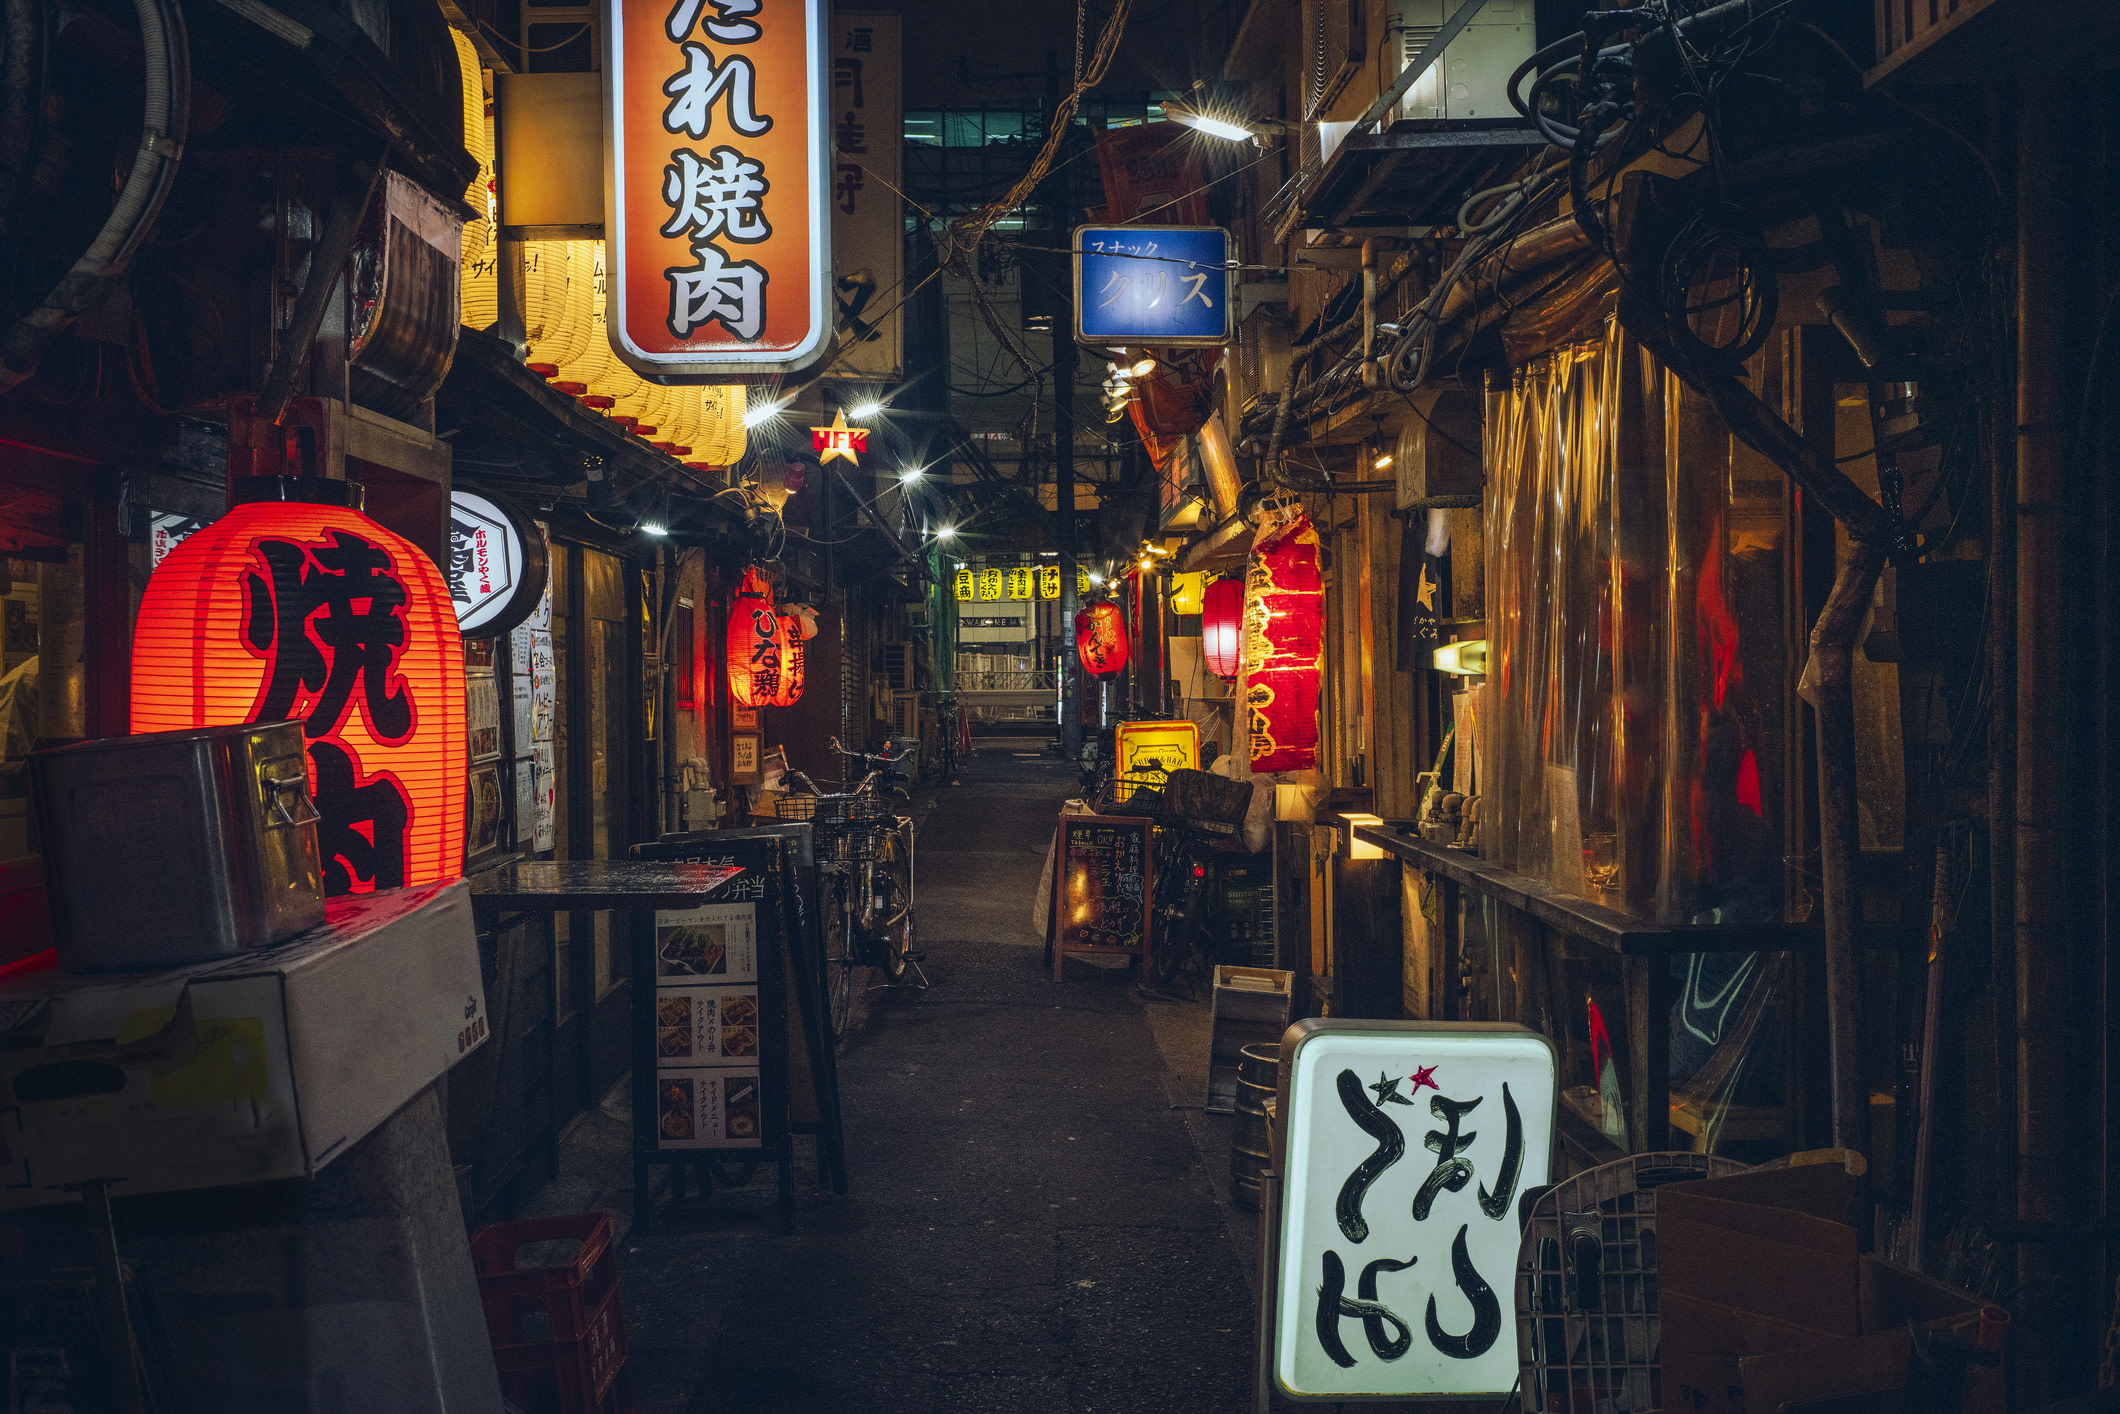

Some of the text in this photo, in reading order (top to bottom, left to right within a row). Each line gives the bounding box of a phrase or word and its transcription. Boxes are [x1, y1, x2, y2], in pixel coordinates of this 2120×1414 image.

[1091, 240, 1158, 258] スナック
[1097, 269, 1214, 310] クリス
[812, 428, 868, 453] HFK
[965, 618, 1007, 626] WAKRE
[1412, 626, 1438, 640] ぐみ
[751, 608, 781, 698] ひな鶏
